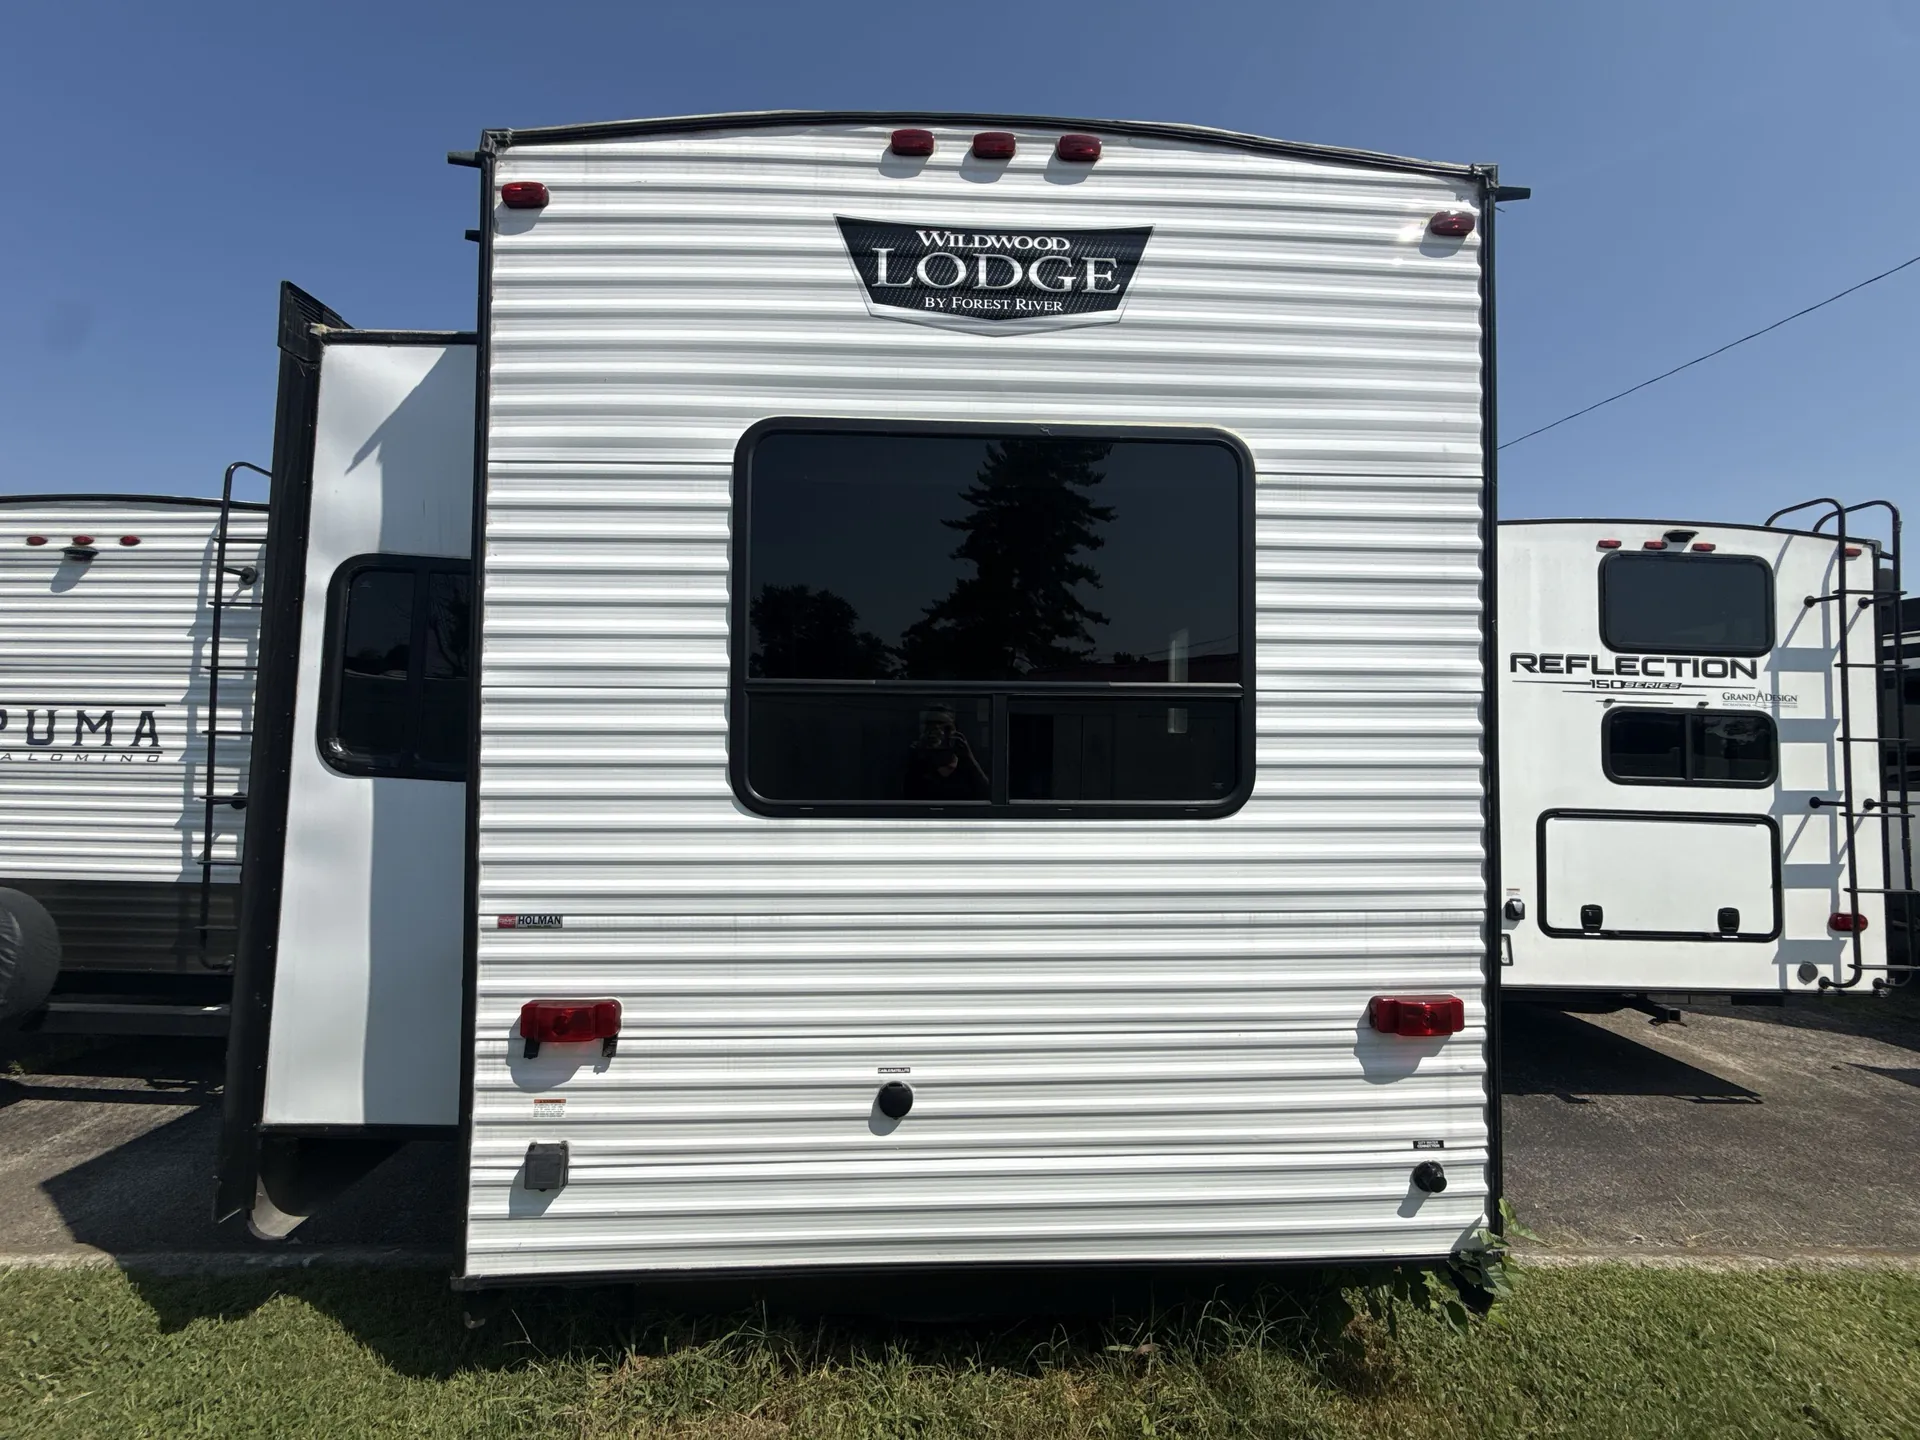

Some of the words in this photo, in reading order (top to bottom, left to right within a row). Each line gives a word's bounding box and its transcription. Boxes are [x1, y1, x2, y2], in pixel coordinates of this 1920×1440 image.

[916, 230, 1071, 250] WILDWOOD
[872, 247, 1121, 294] LODGE
[925, 297, 947, 309] BY
[952, 296, 1010, 310] FOREST
[1015, 297, 1063, 312] RIVER
[1510, 652, 1758, 680] REFLECTION
[1722, 692, 1756, 701] GRAND
[1765, 693, 1798, 702] DESIGN
[0, 753, 160, 763] ALOMINO
[518, 915, 561, 925] HOLMAN
